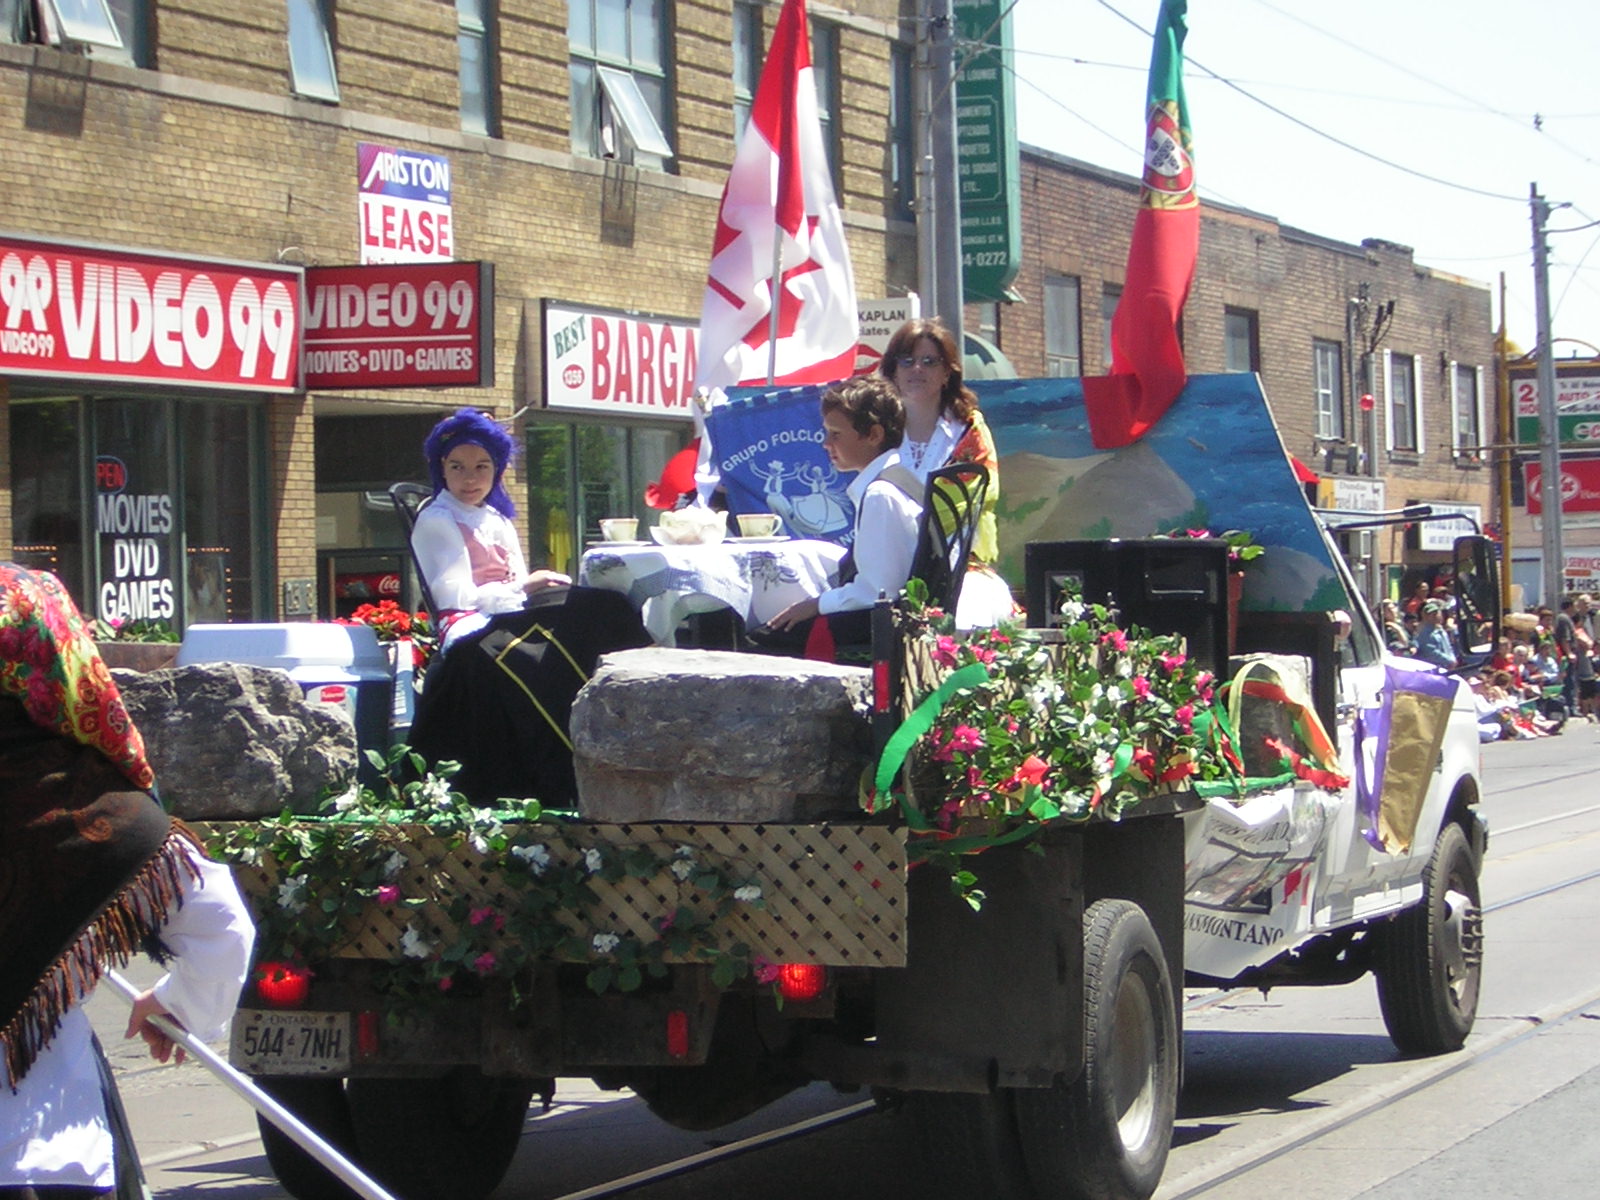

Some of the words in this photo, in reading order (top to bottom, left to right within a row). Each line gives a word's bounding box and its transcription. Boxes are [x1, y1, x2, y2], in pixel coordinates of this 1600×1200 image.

[362, 151, 450, 192] ARISTON
[363, 201, 451, 257] LEASE
[56, 258, 225, 370] VIDEO
[229, 276, 295, 380] 99
[304, 281, 418, 330] VIDEO
[422, 279, 474, 330] 99
[857, 309, 906, 322] KAPLAN
[553, 313, 587, 360] BEST
[721, 439, 769, 473] GRUPO
[98, 493, 173, 534] MOVIES
[114, 537, 159, 578] DVD
[101, 578, 175, 624] GAMES
